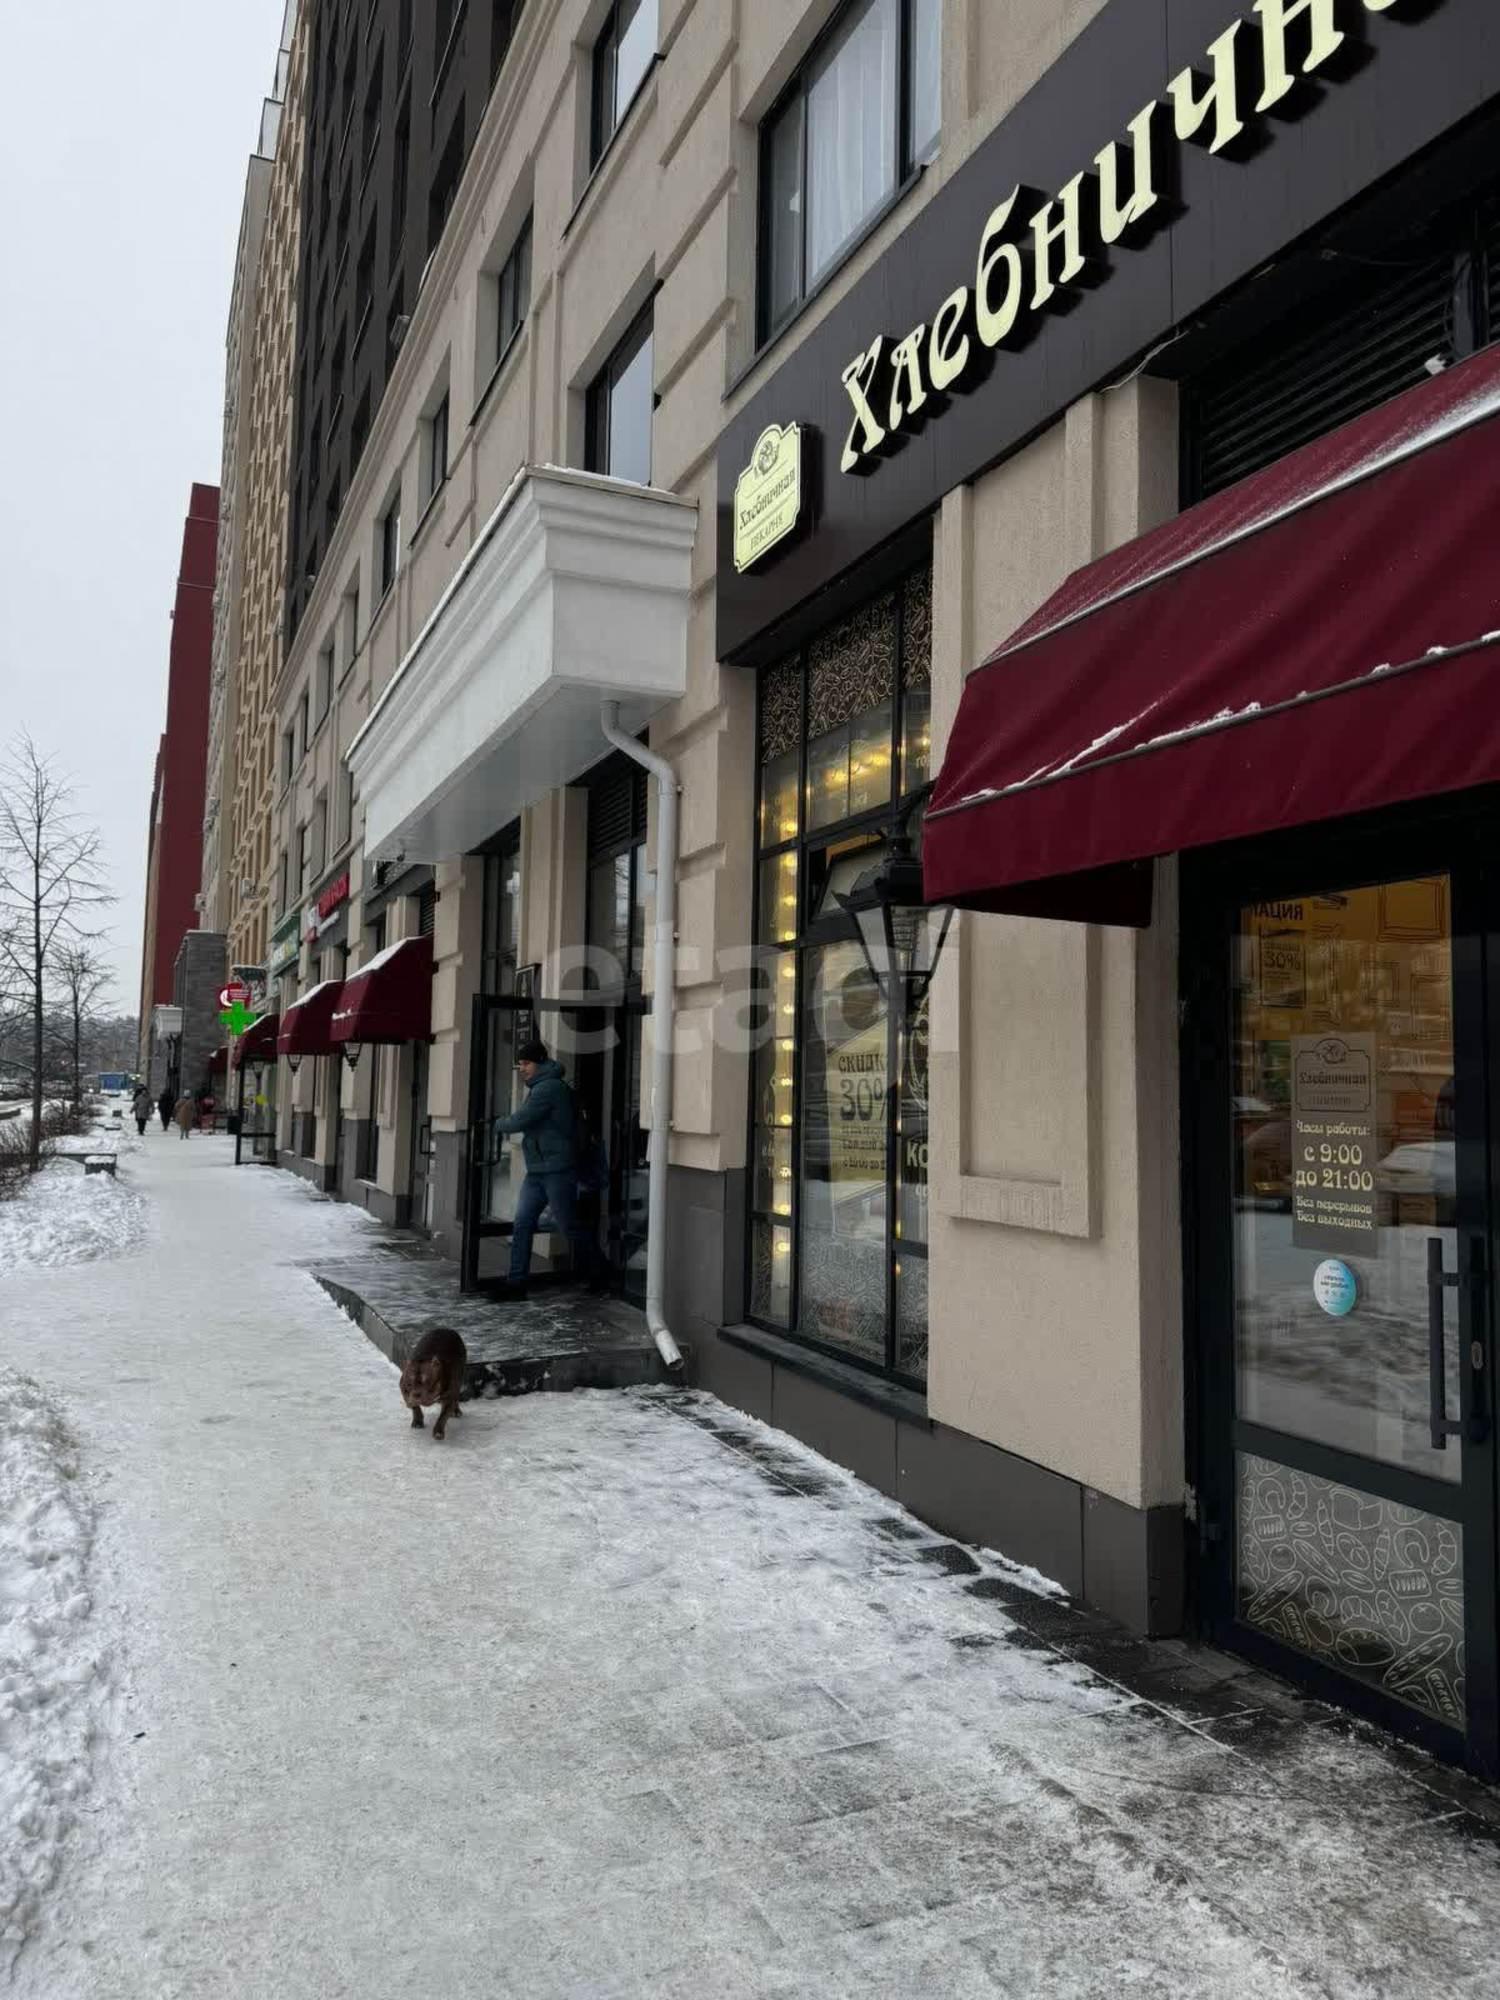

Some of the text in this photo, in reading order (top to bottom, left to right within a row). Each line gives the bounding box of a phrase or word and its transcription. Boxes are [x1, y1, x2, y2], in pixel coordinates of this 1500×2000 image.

[841, 0, 1397, 473] Хлебничн
[1296, 1119, 1371, 1136] Часы работы:
[1320, 1143, 1363, 1164] 9:00
[1295, 1168, 1373, 1191] до 21:00
[1296, 1195, 1314, 1208] Без
[1296, 1210, 1373, 1230] Без выходных
